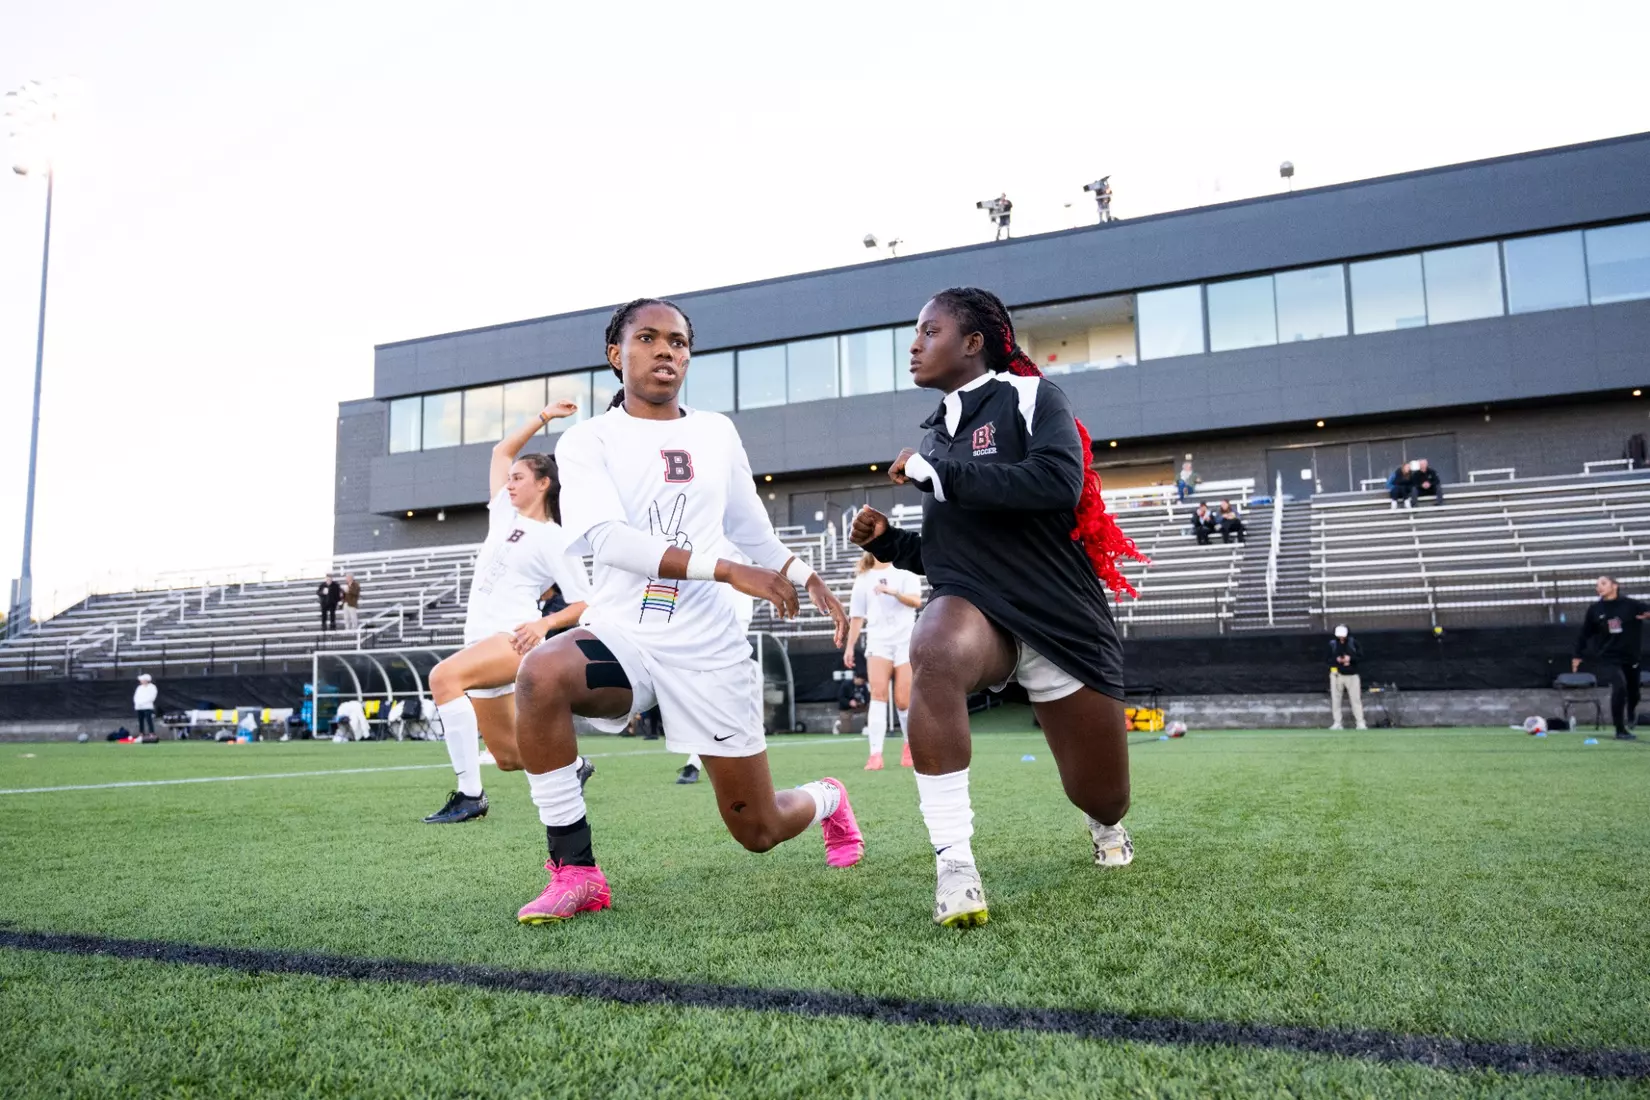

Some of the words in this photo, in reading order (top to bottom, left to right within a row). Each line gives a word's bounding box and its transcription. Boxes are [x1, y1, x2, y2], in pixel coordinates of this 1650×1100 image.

[972, 425, 991, 450] B
[972, 447, 998, 457] SOCCER
[660, 449, 695, 483] B
[506, 529, 526, 543] B
